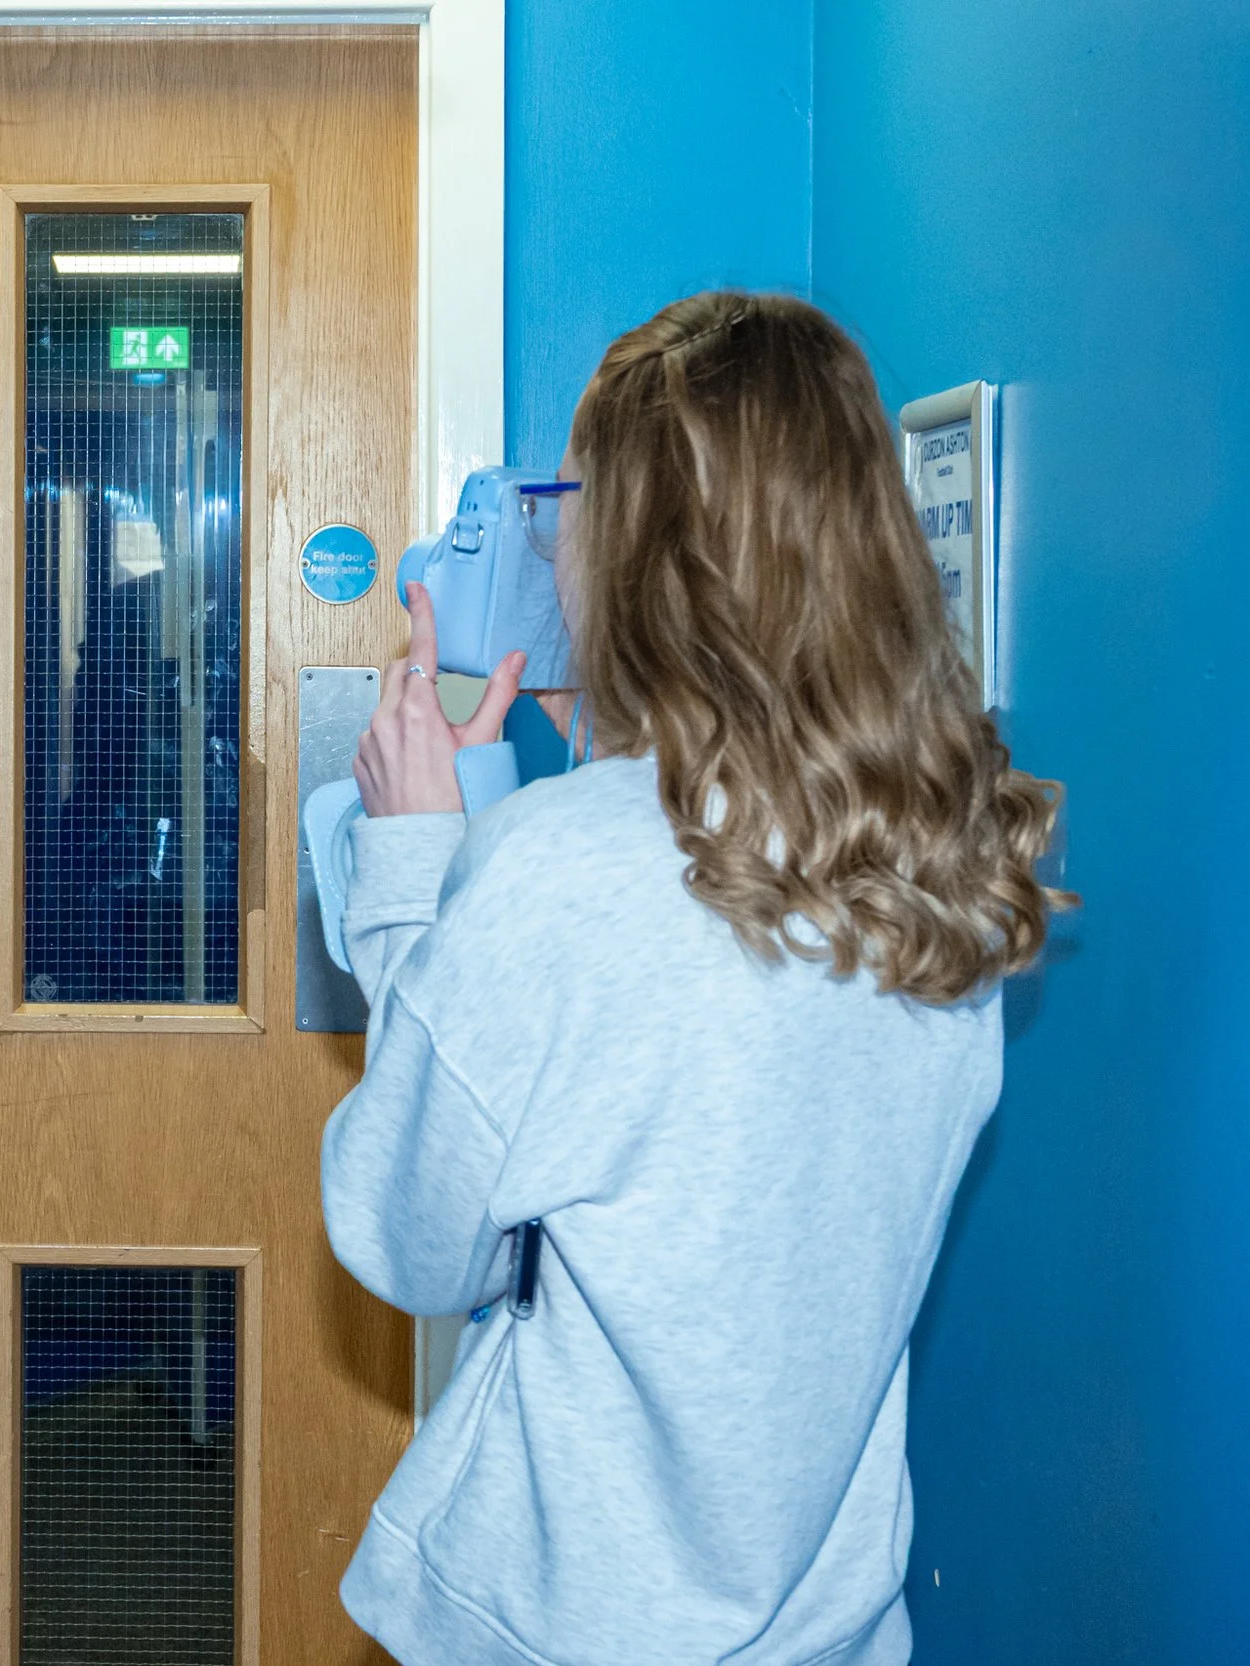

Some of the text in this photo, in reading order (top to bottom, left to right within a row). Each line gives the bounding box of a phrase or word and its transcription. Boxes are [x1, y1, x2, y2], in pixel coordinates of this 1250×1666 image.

[941, 503, 954, 538] UP
[313, 551, 363, 562] Fire door
[310, 564, 366, 576] keep shut
